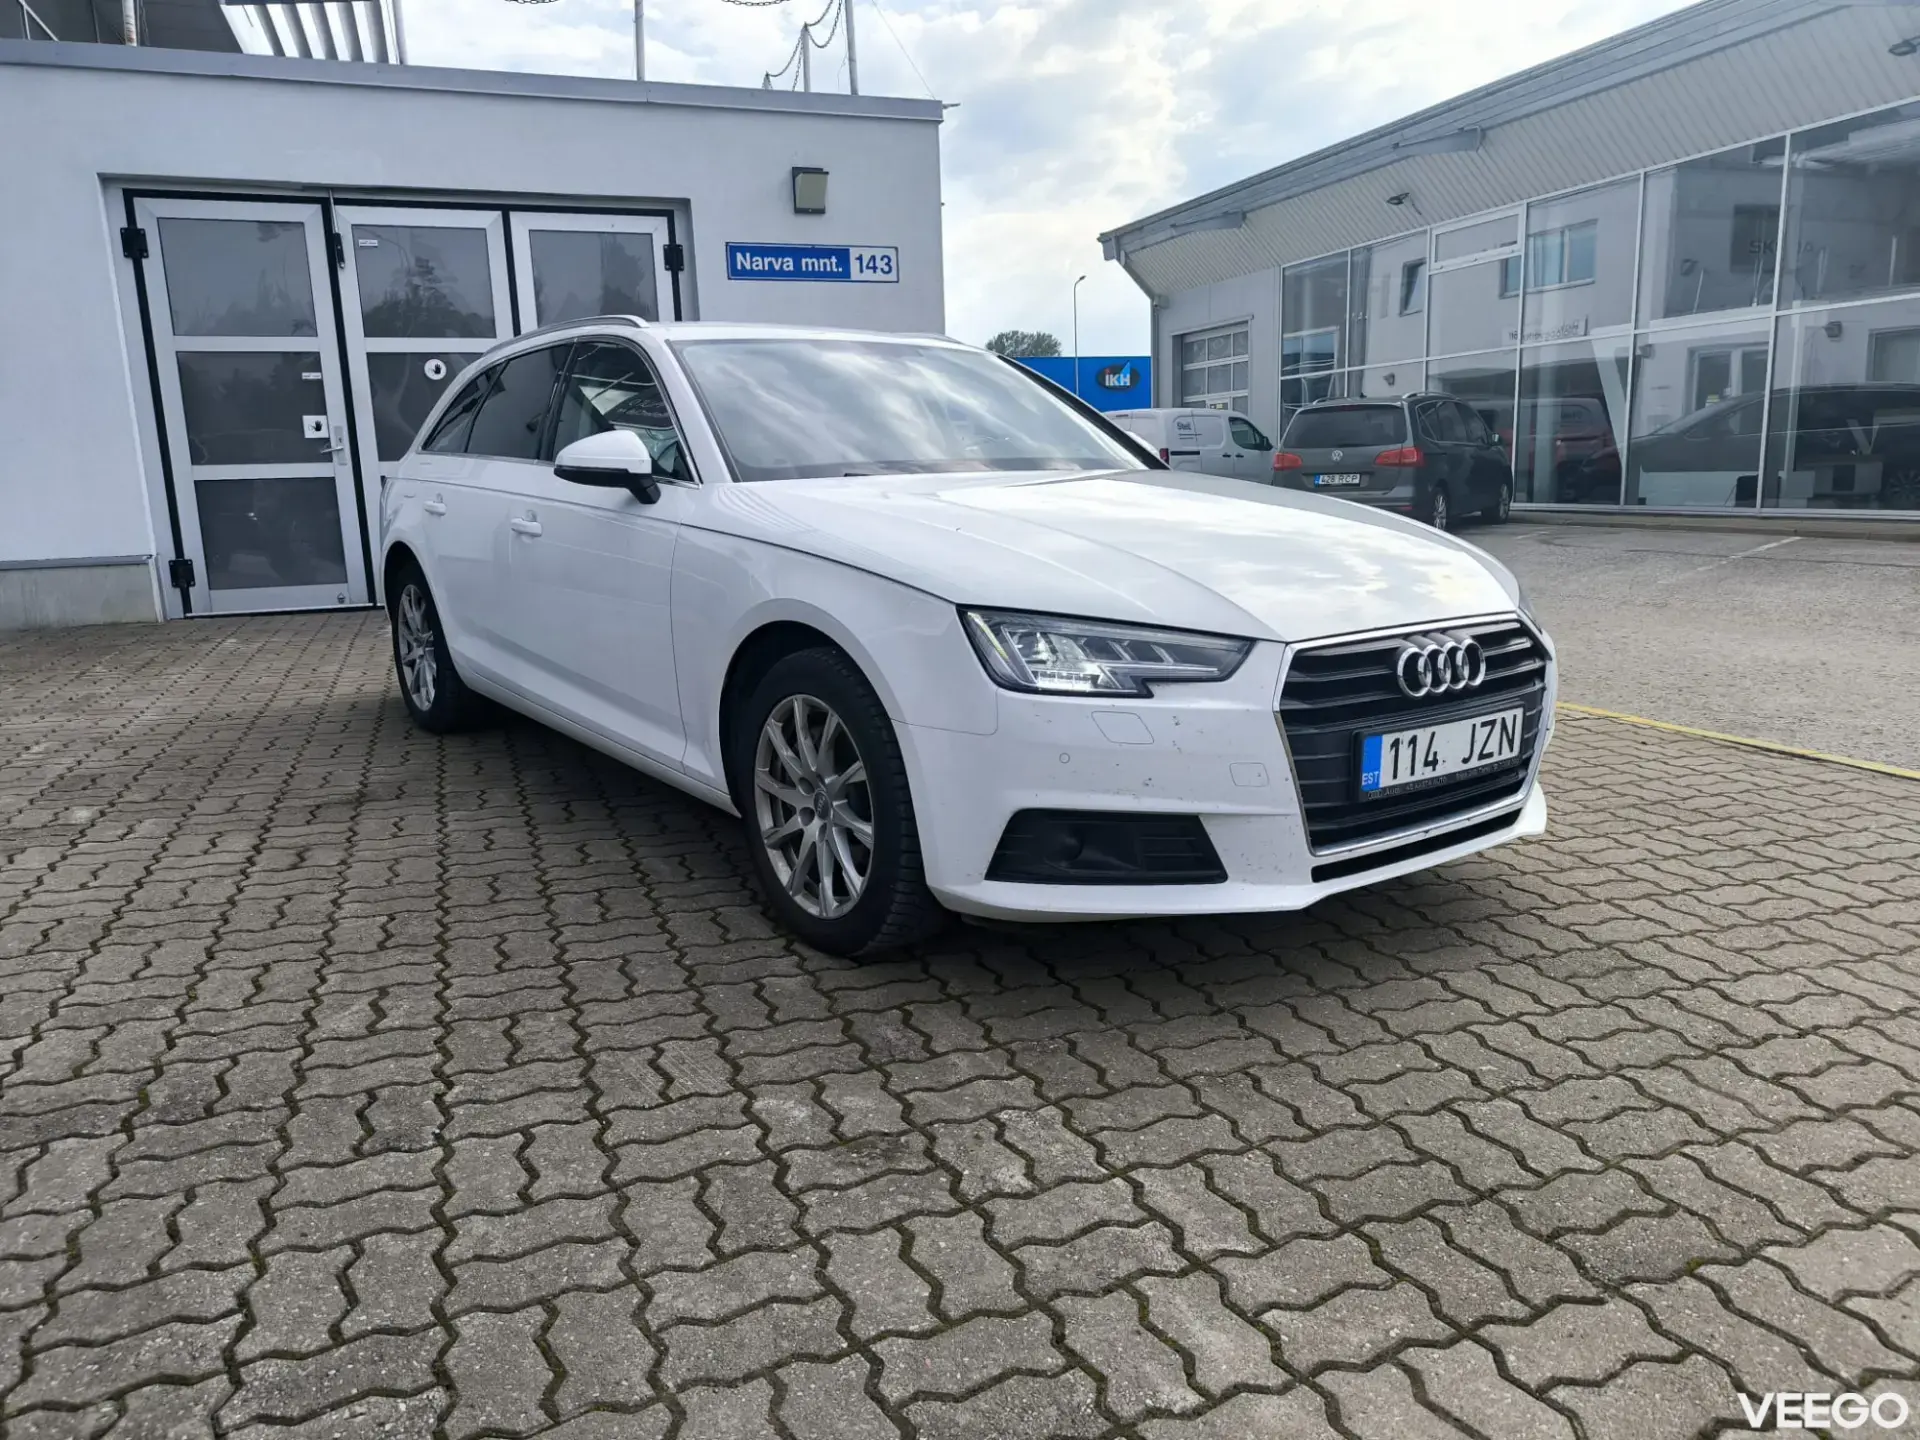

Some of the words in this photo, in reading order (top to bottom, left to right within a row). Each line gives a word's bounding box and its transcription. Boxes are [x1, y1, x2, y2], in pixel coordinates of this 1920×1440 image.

[735, 252, 794, 271] Narva
[801, 255, 843, 272] mnt.
[854, 253, 893, 274] 143
[1389, 731, 1439, 780] 114
[1461, 714, 1517, 764] JZN
[1361, 771, 1380, 785] EST
